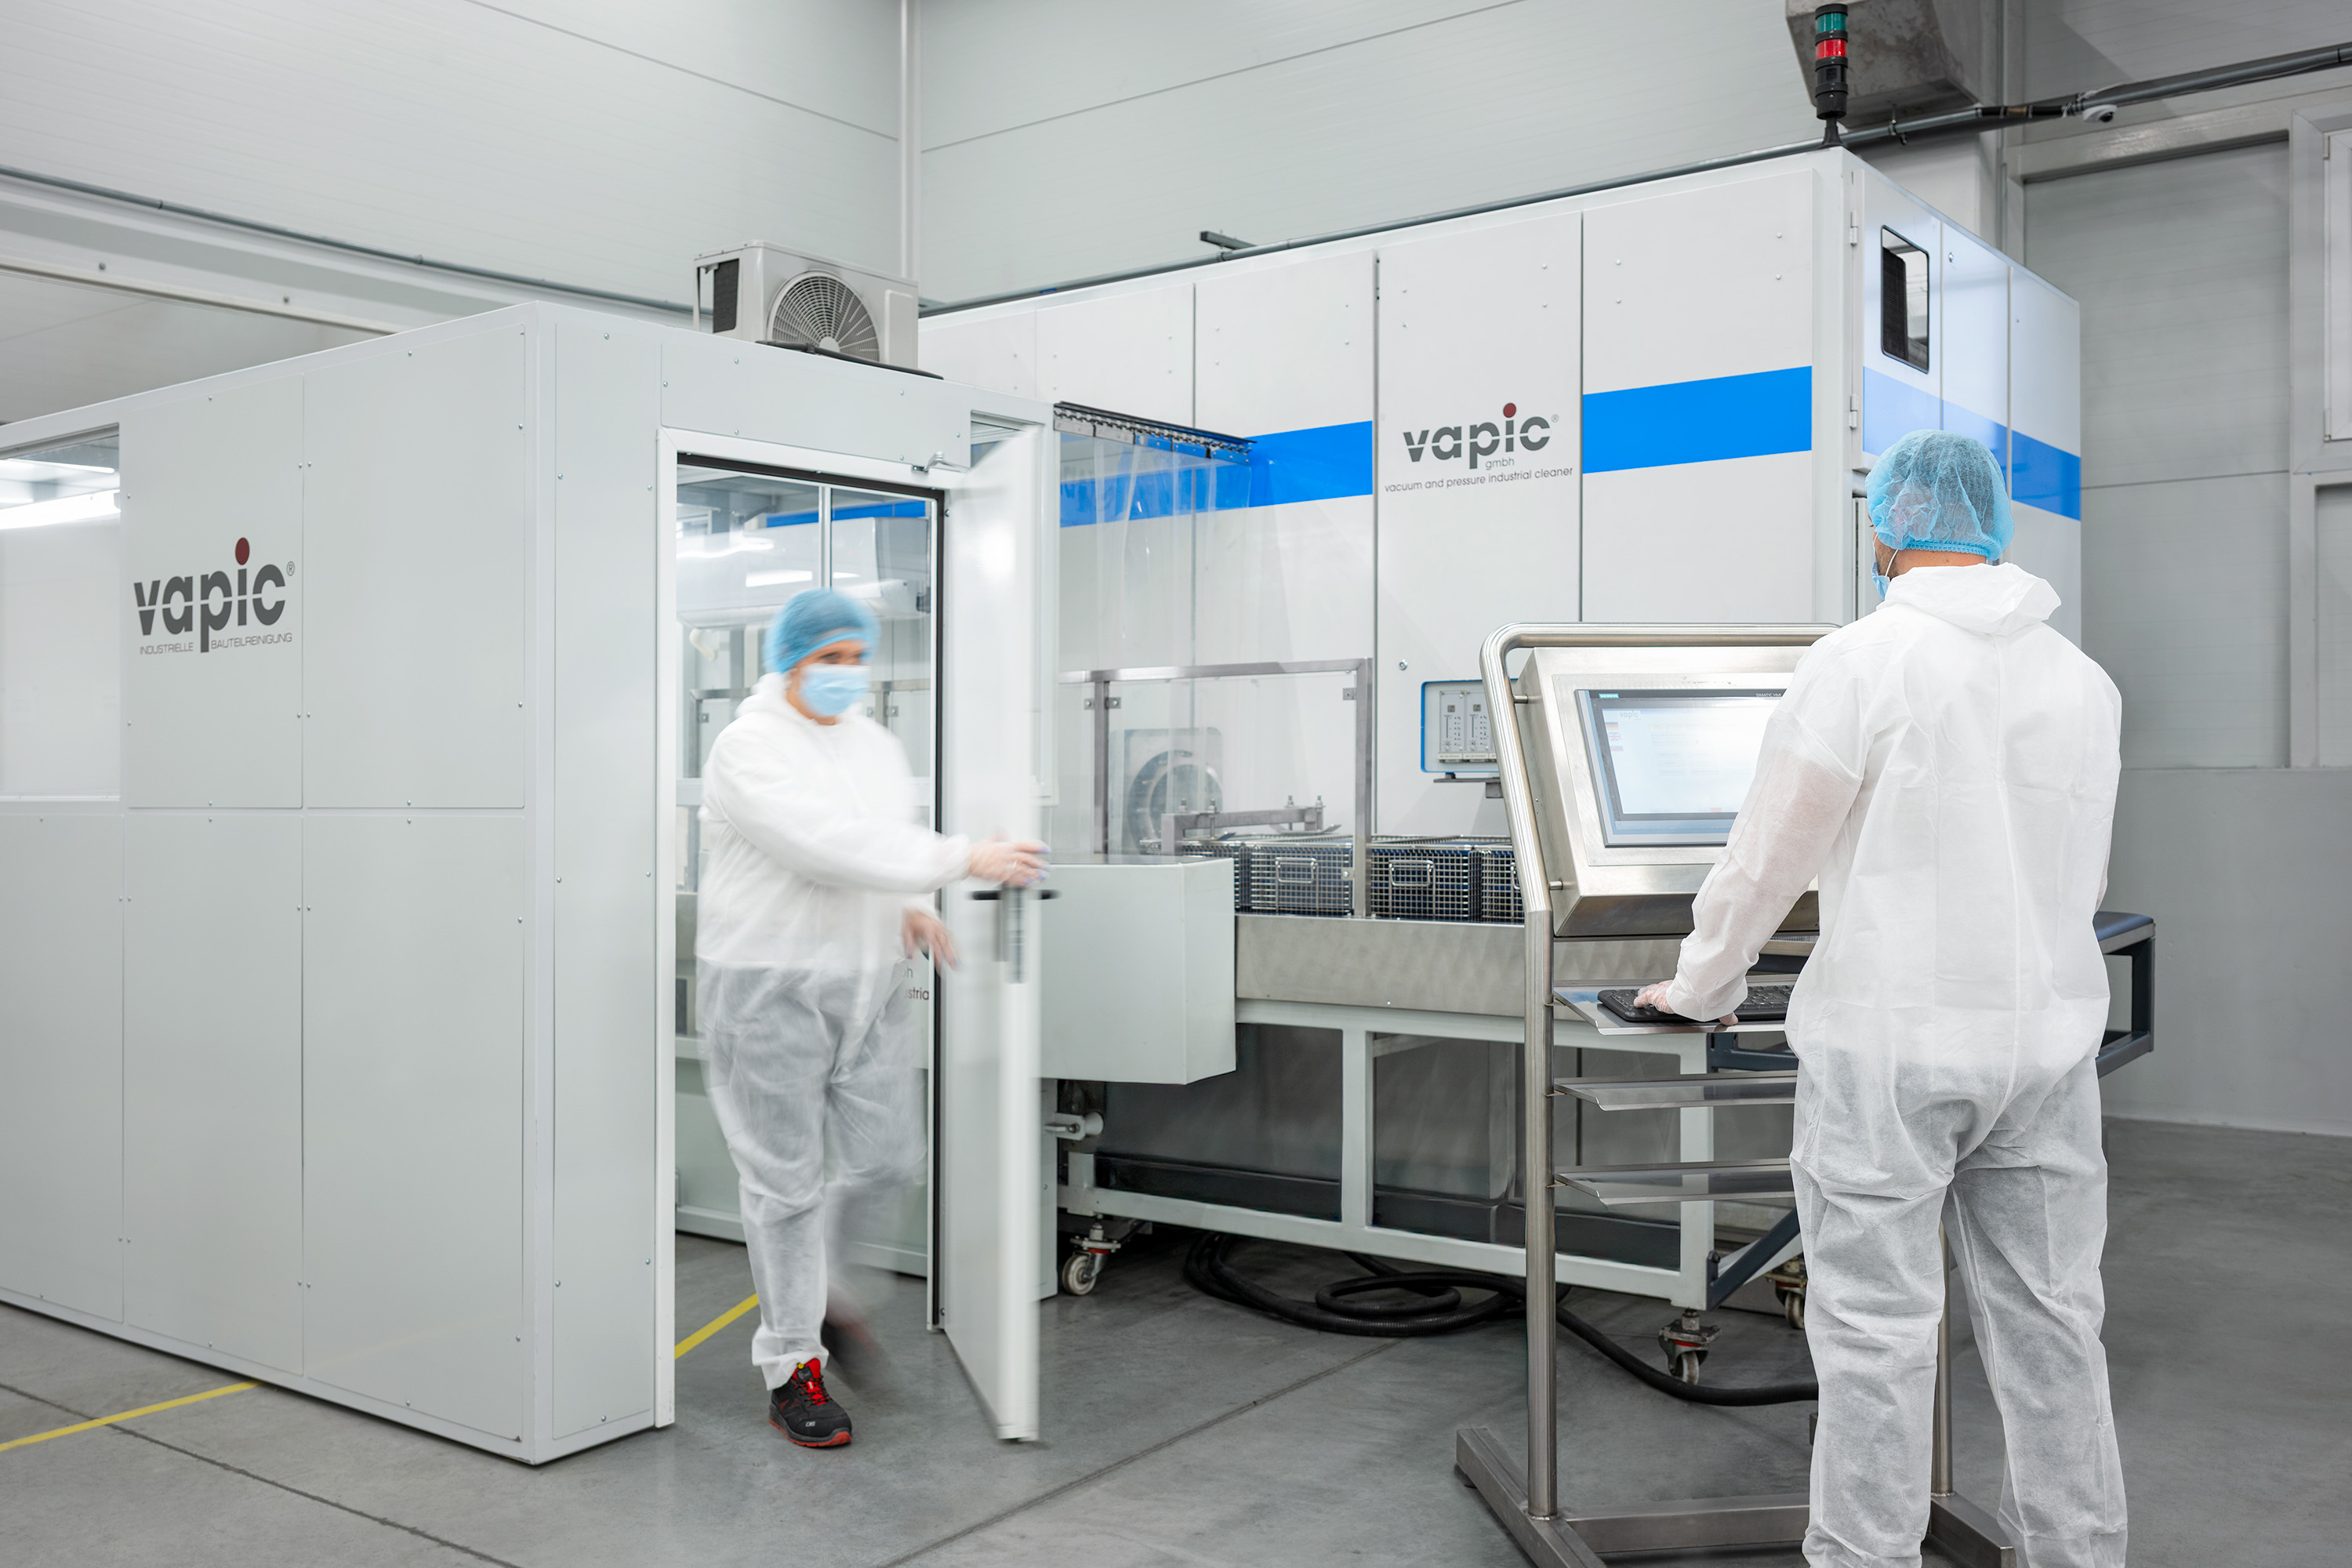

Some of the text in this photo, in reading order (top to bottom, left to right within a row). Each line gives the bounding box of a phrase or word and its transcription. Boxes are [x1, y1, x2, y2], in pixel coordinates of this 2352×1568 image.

[1485, 457, 1515, 470] gmbh
[1385, 466, 1573, 492] vacuum and pressure industrial cleaner
[140, 632, 292, 655] INDUSTRIELLE BAUTEILREINIGUNG
